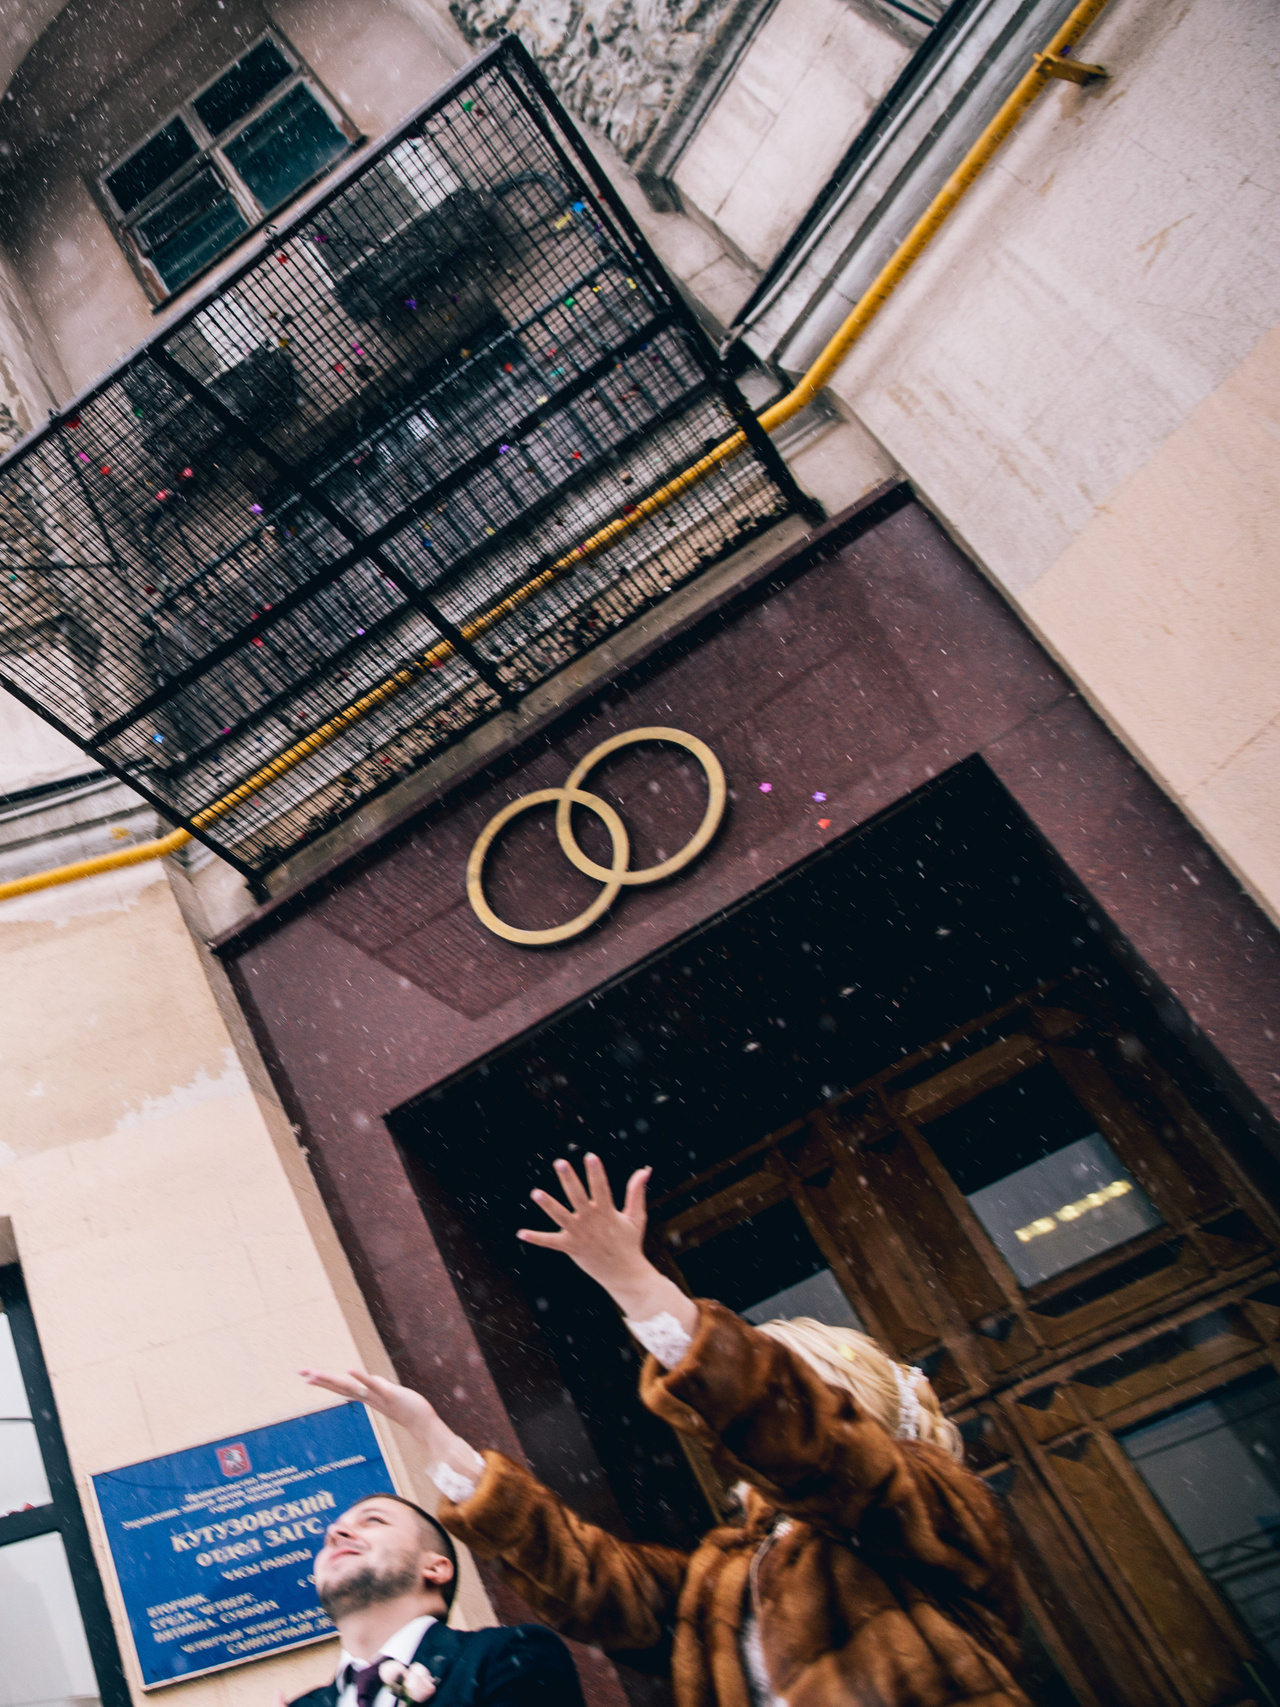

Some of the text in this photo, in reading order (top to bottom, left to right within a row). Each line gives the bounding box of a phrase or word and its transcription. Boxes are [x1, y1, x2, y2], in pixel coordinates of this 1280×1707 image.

[171, 1491, 336, 1552] КУТУЗОВСКИЙ
[196, 1517, 325, 1567] отдел ЗАГС
